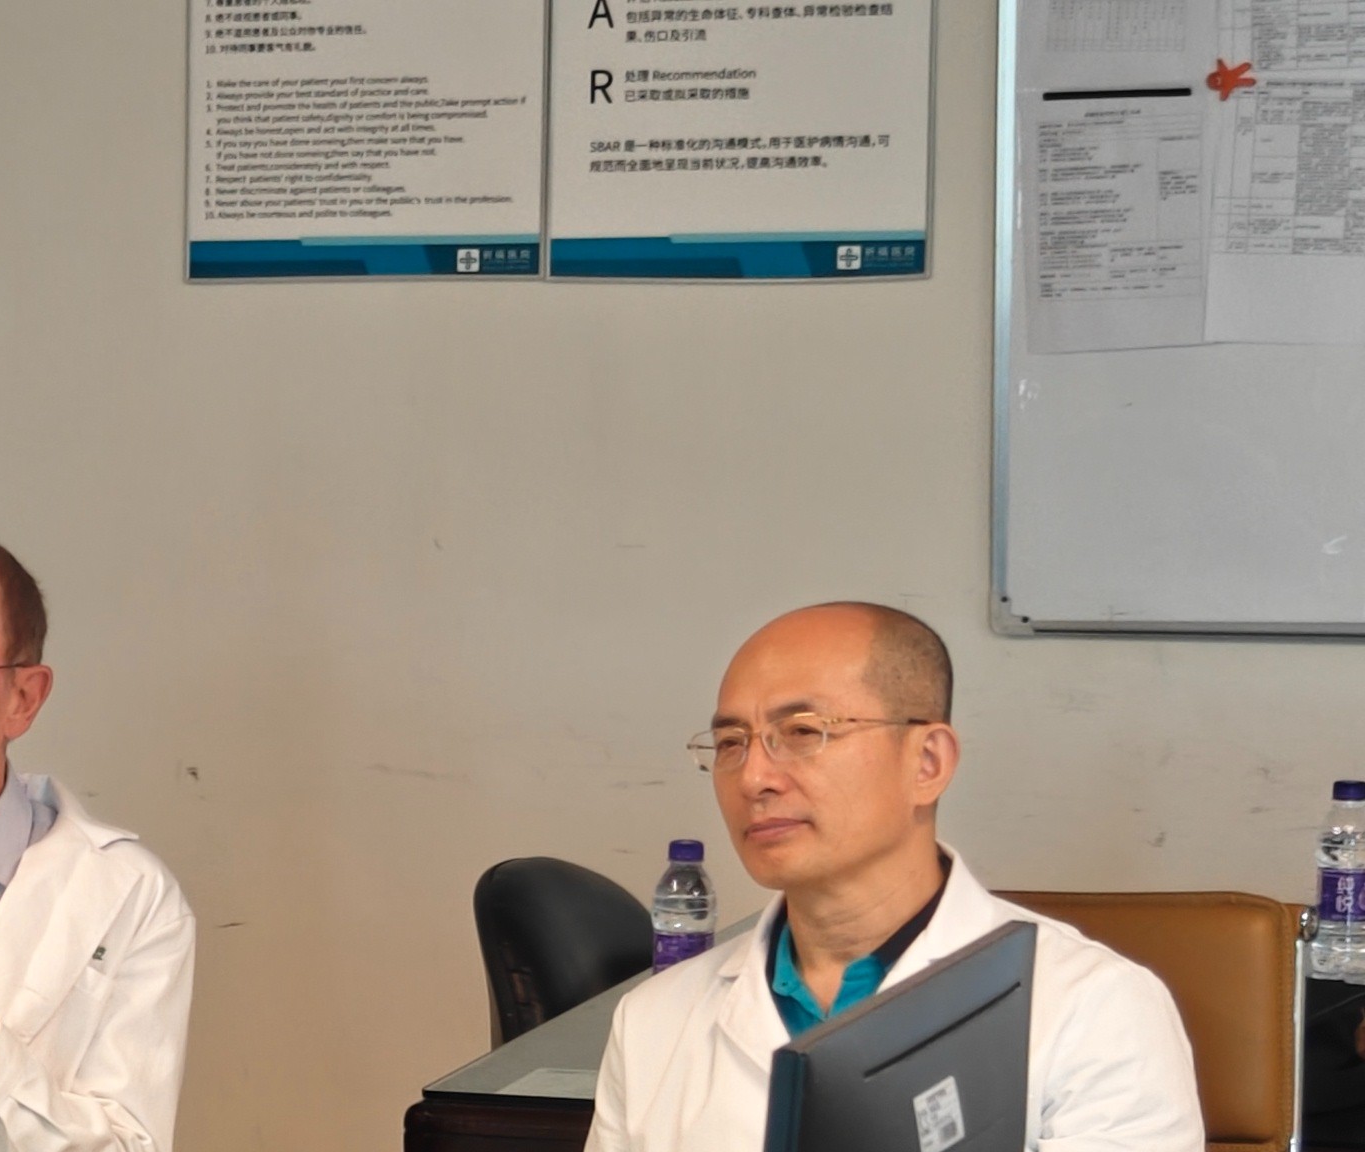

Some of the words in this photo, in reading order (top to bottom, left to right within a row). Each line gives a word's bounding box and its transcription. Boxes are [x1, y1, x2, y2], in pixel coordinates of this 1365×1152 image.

[588, 0, 614, 29] A
[626, 29, 707, 43] 果、伤口及引流
[625, 70, 649, 82] 处理
[653, 67, 757, 81] Recommendation
[590, 70, 613, 104] R
[625, 88, 750, 102] 已采取或拟采取的措施
[590, 141, 621, 153] SBAR
